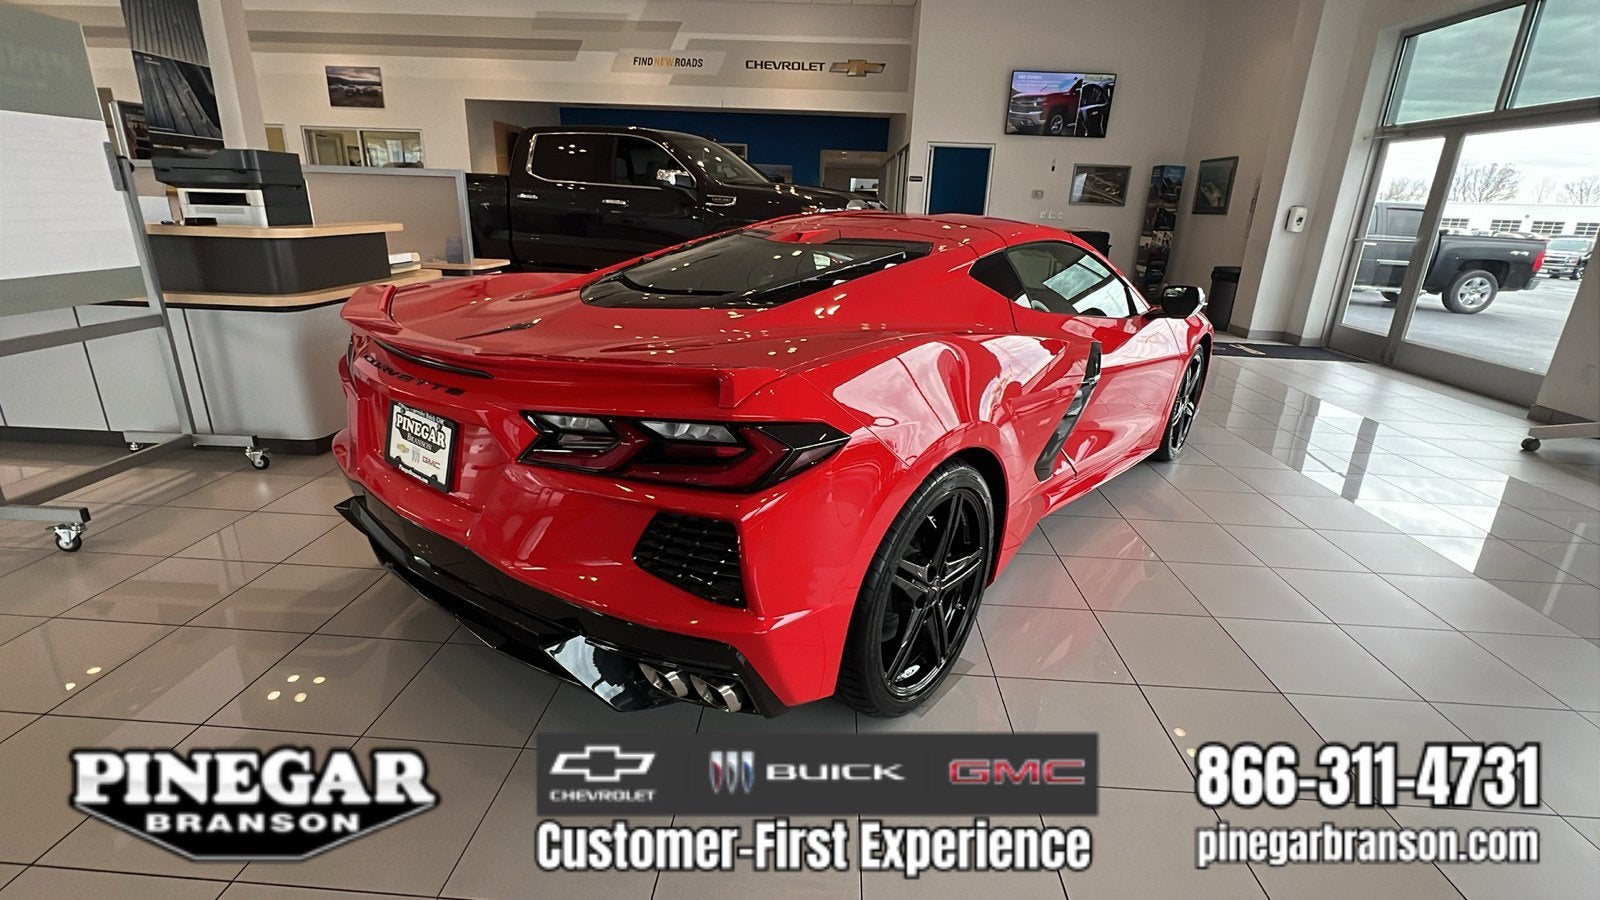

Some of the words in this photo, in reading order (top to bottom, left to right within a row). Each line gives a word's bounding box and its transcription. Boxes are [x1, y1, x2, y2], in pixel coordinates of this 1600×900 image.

[633, 57, 653, 66] FIND
[654, 57, 673, 66] NEW
[674, 57, 703, 67] ROADS
[745, 60, 826, 71] CHEVROLET
[396, 413, 447, 449] PINEGAR
[422, 455, 441, 469] GMC
